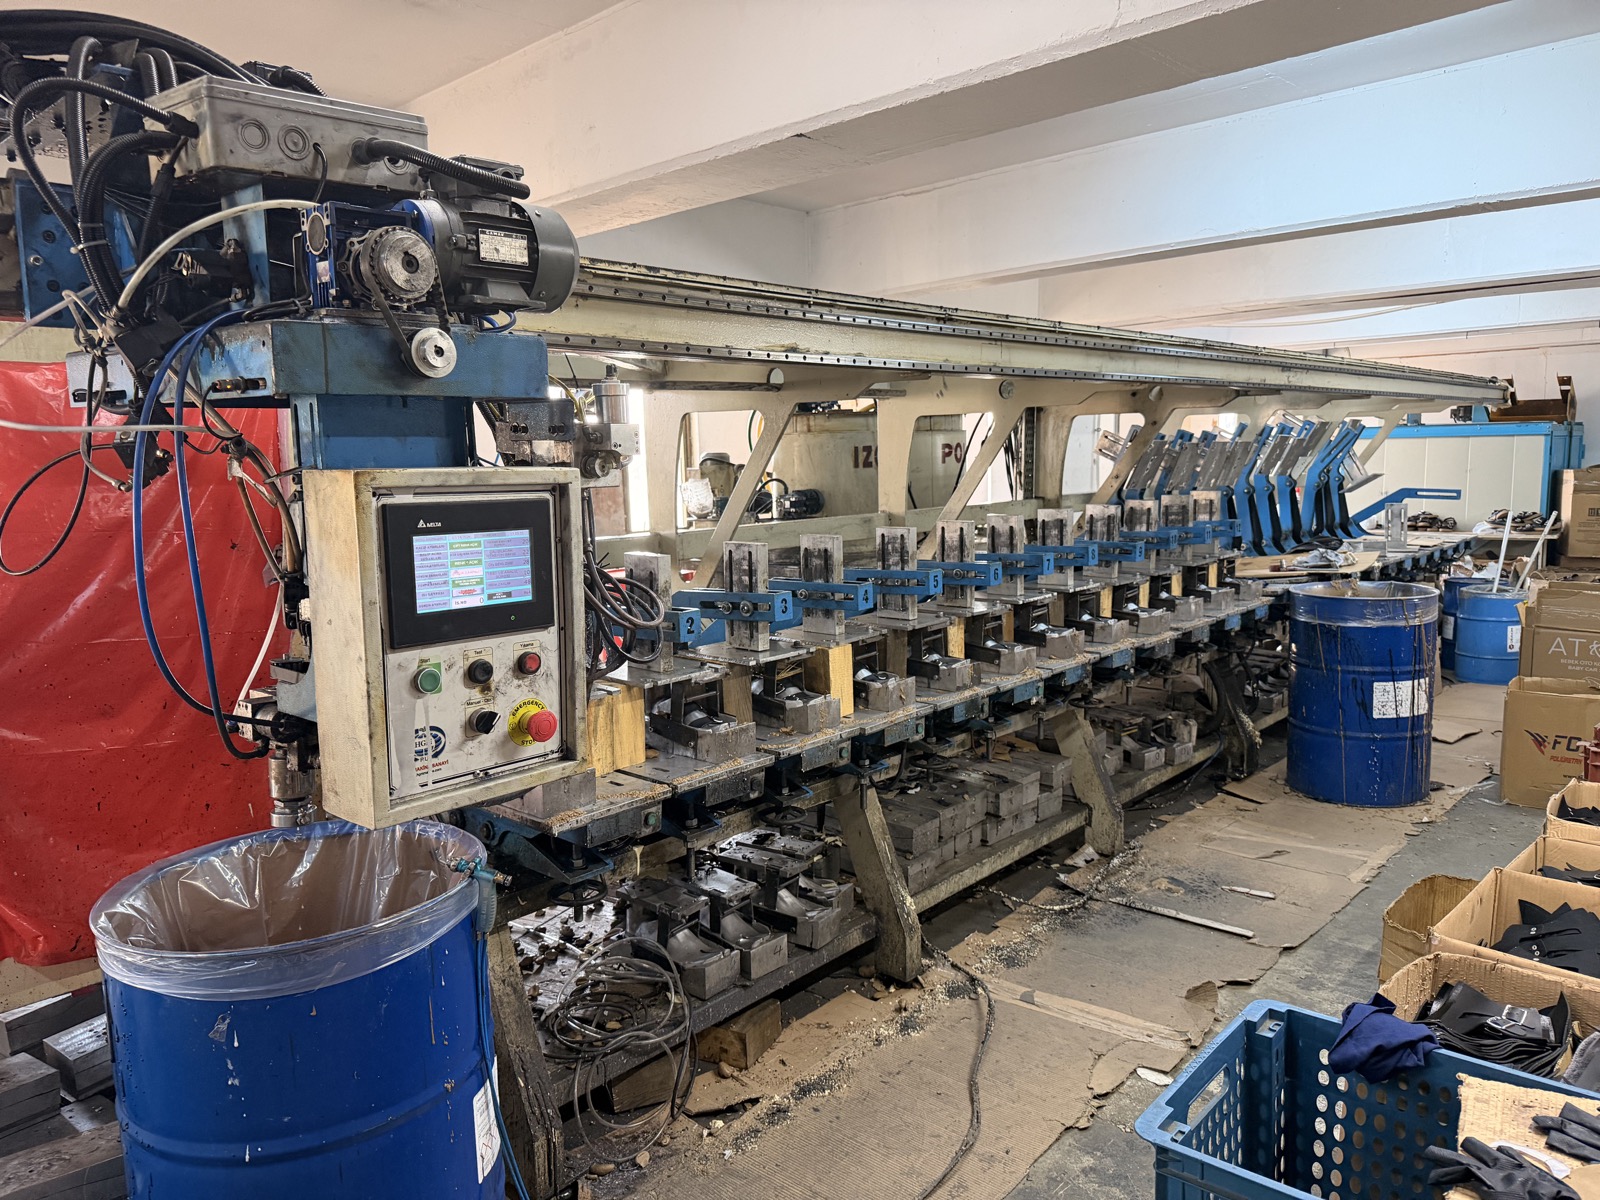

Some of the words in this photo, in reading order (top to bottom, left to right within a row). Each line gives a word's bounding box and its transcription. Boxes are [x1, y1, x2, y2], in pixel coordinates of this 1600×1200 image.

[942, 442, 965, 464] PO
[1046, 558, 1051, 571] 7
[933, 575, 939, 588] 5
[993, 568, 999, 581] 6
[862, 588, 869, 604] 4
[781, 598, 788, 614] 3
[685, 616, 695, 635] 2
[512, 700, 544, 717] EMERGENCY
